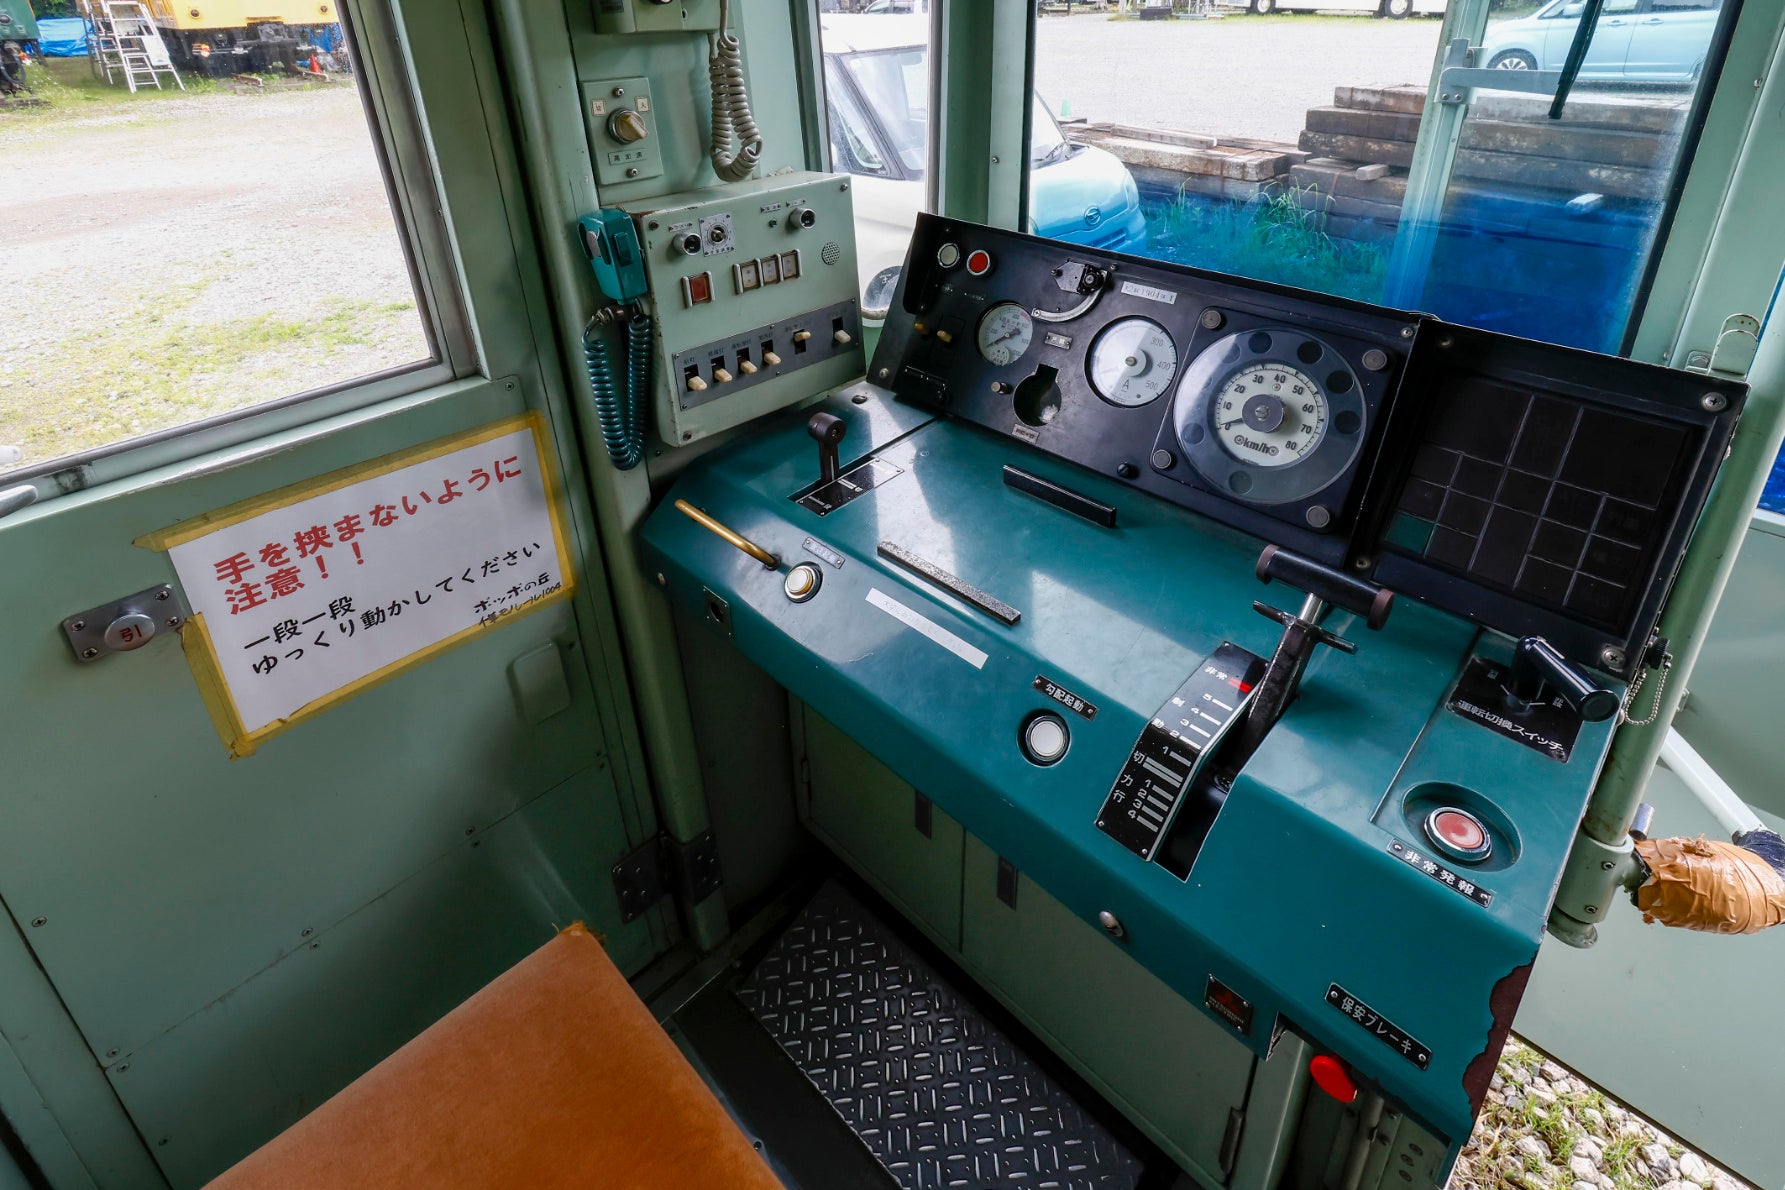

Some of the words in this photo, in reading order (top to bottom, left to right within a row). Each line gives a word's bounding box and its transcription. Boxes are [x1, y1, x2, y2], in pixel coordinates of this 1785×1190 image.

[1150, 336, 1164, 347] 300
[1156, 361, 1171, 370] 400
[1252, 374, 1264, 384] 30
[1273, 373, 1286, 384] 40
[1121, 379, 1130, 390] A
[1144, 380, 1159, 391] 500
[1233, 383, 1246, 394] 20
[1292, 384, 1305, 395] 50
[1222, 401, 1232, 411] 10
[1302, 403, 1314, 413] 60
[1224, 421, 1231, 431] 0
[1300, 423, 1312, 434] 70
[1242, 436, 1270, 454] km/h
[1285, 440, 1297, 451] 80
[213, 455, 523, 585] 手を挟まないように
[251, 542, 541, 676] ゆっくり動かしてください
[243, 595, 357, 650] 一段一段
[119, 623, 142, 642] 引
[1204, 665, 1229, 681] 非常
[1045, 682, 1084, 713] 勾配起動
[1202, 693, 1212, 701] 5
[1191, 707, 1200, 715] 4
[1180, 718, 1190, 727] 3
[1457, 699, 1565, 752] 運転切換スイッチ
[1169, 729, 1180, 738] 2
[1162, 746, 1169, 755] 1
[1133, 750, 1145, 764] 切
[1145, 778, 1151, 787] 1
[1137, 788, 1147, 798] 2
[1132, 798, 1142, 809] 3
[1127, 810, 1137, 819] 4
[1404, 850, 1475, 896] 非常発報
[1340, 996, 1412, 1055] 保安ブレーキ
